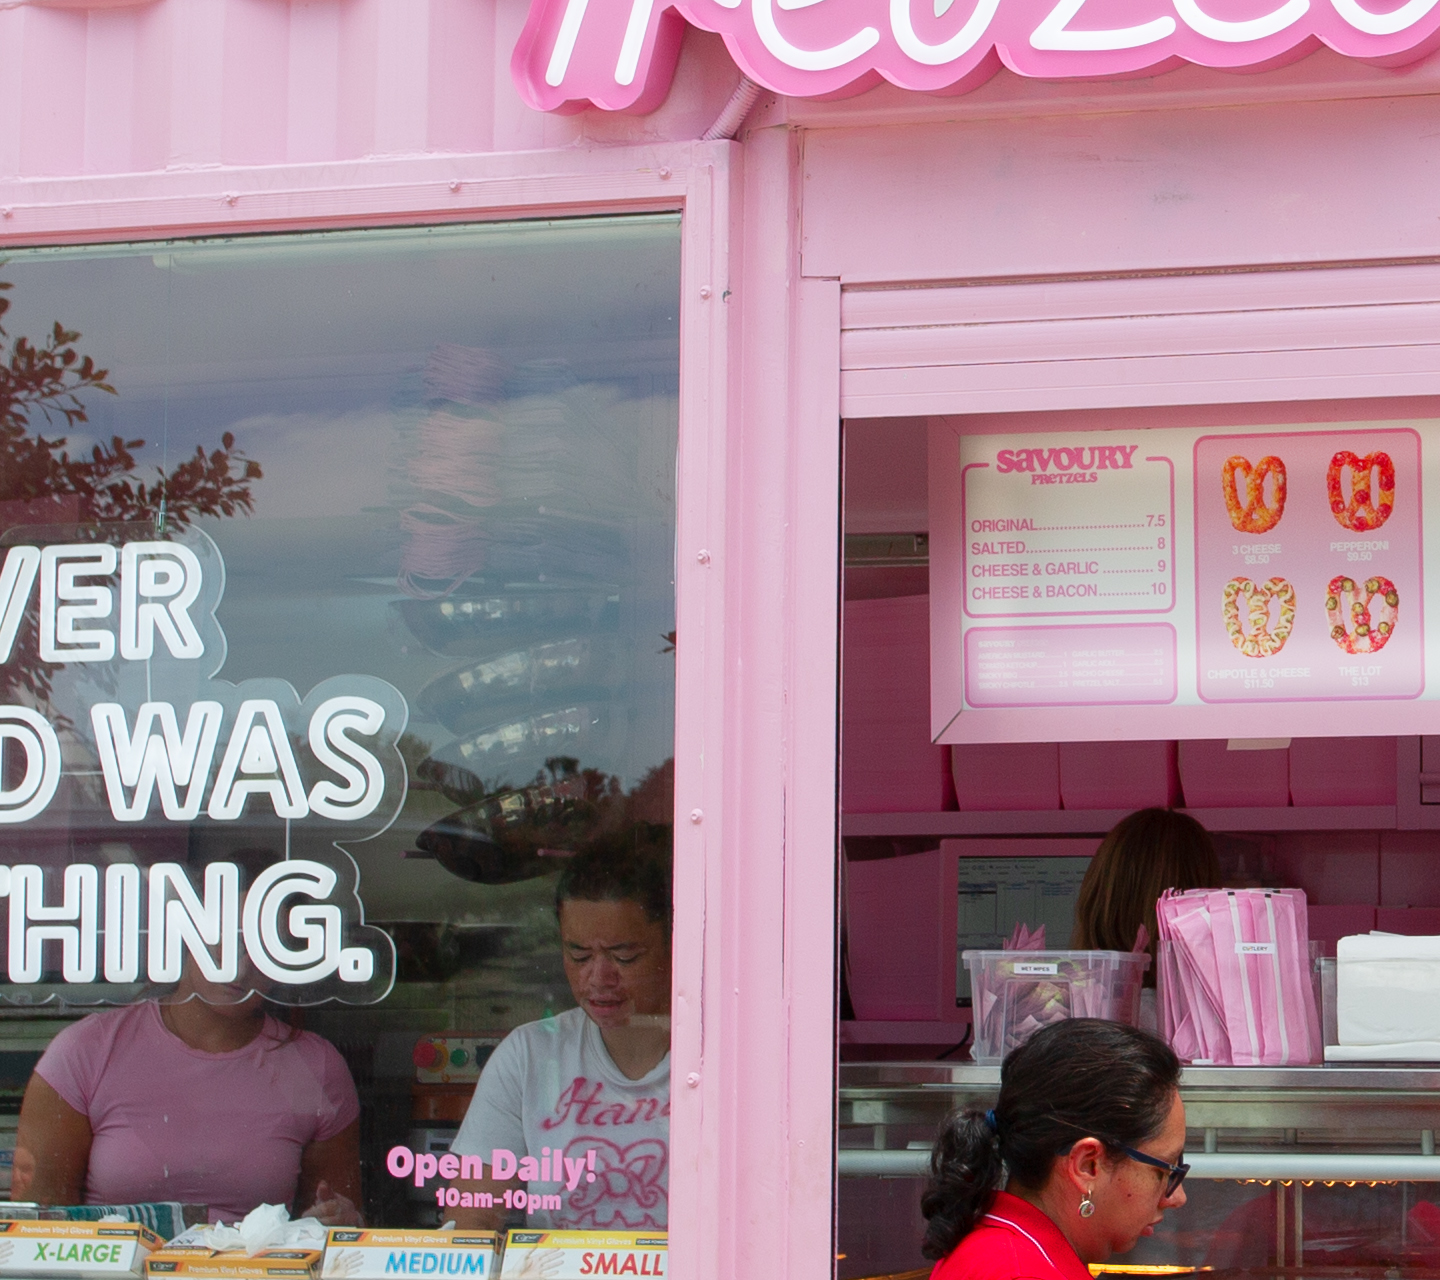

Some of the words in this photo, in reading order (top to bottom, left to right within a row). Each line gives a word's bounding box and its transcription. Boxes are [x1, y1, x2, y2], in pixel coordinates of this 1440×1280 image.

[972, 518, 1037, 533] ORIGINAL
[1146, 515, 1166, 528] 7.5
[972, 541, 1025, 556] SALTED
[1231, 545, 1238, 555] 3
[1240, 544, 1281, 555] CHEESE
[1330, 541, 1389, 552] PEPPERONI
[972, 564, 1029, 578] CHEESE
[1032, 563, 1042, 576] &
[1045, 561, 1099, 575] GARLIC
[972, 587, 1029, 601] CHEESE
[1032, 586, 1042, 599] &
[1046, 583, 1097, 598] BACON
[1151, 582, 1167, 596] 10
[1207, 669, 1259, 680] CHIPOTLE
[1269, 667, 1310, 678] CHEESE
[1338, 665, 1358, 676] THE
[1361, 665, 1382, 676] LOT
[89, 695, 387, 823] WAS
[386, 1146, 483, 1187] Open
[491, 1146, 597, 1192] Daily!
[435, 1187, 562, 1215] 10am-10pm
[20, 1225, 51, 1234] Premium
[70, 1227, 94, 1235] Gloves
[34, 1242, 123, 1264] X-LARGE
[384, 1251, 486, 1275] MEDIUM
[579, 1252, 664, 1276] SMALL
